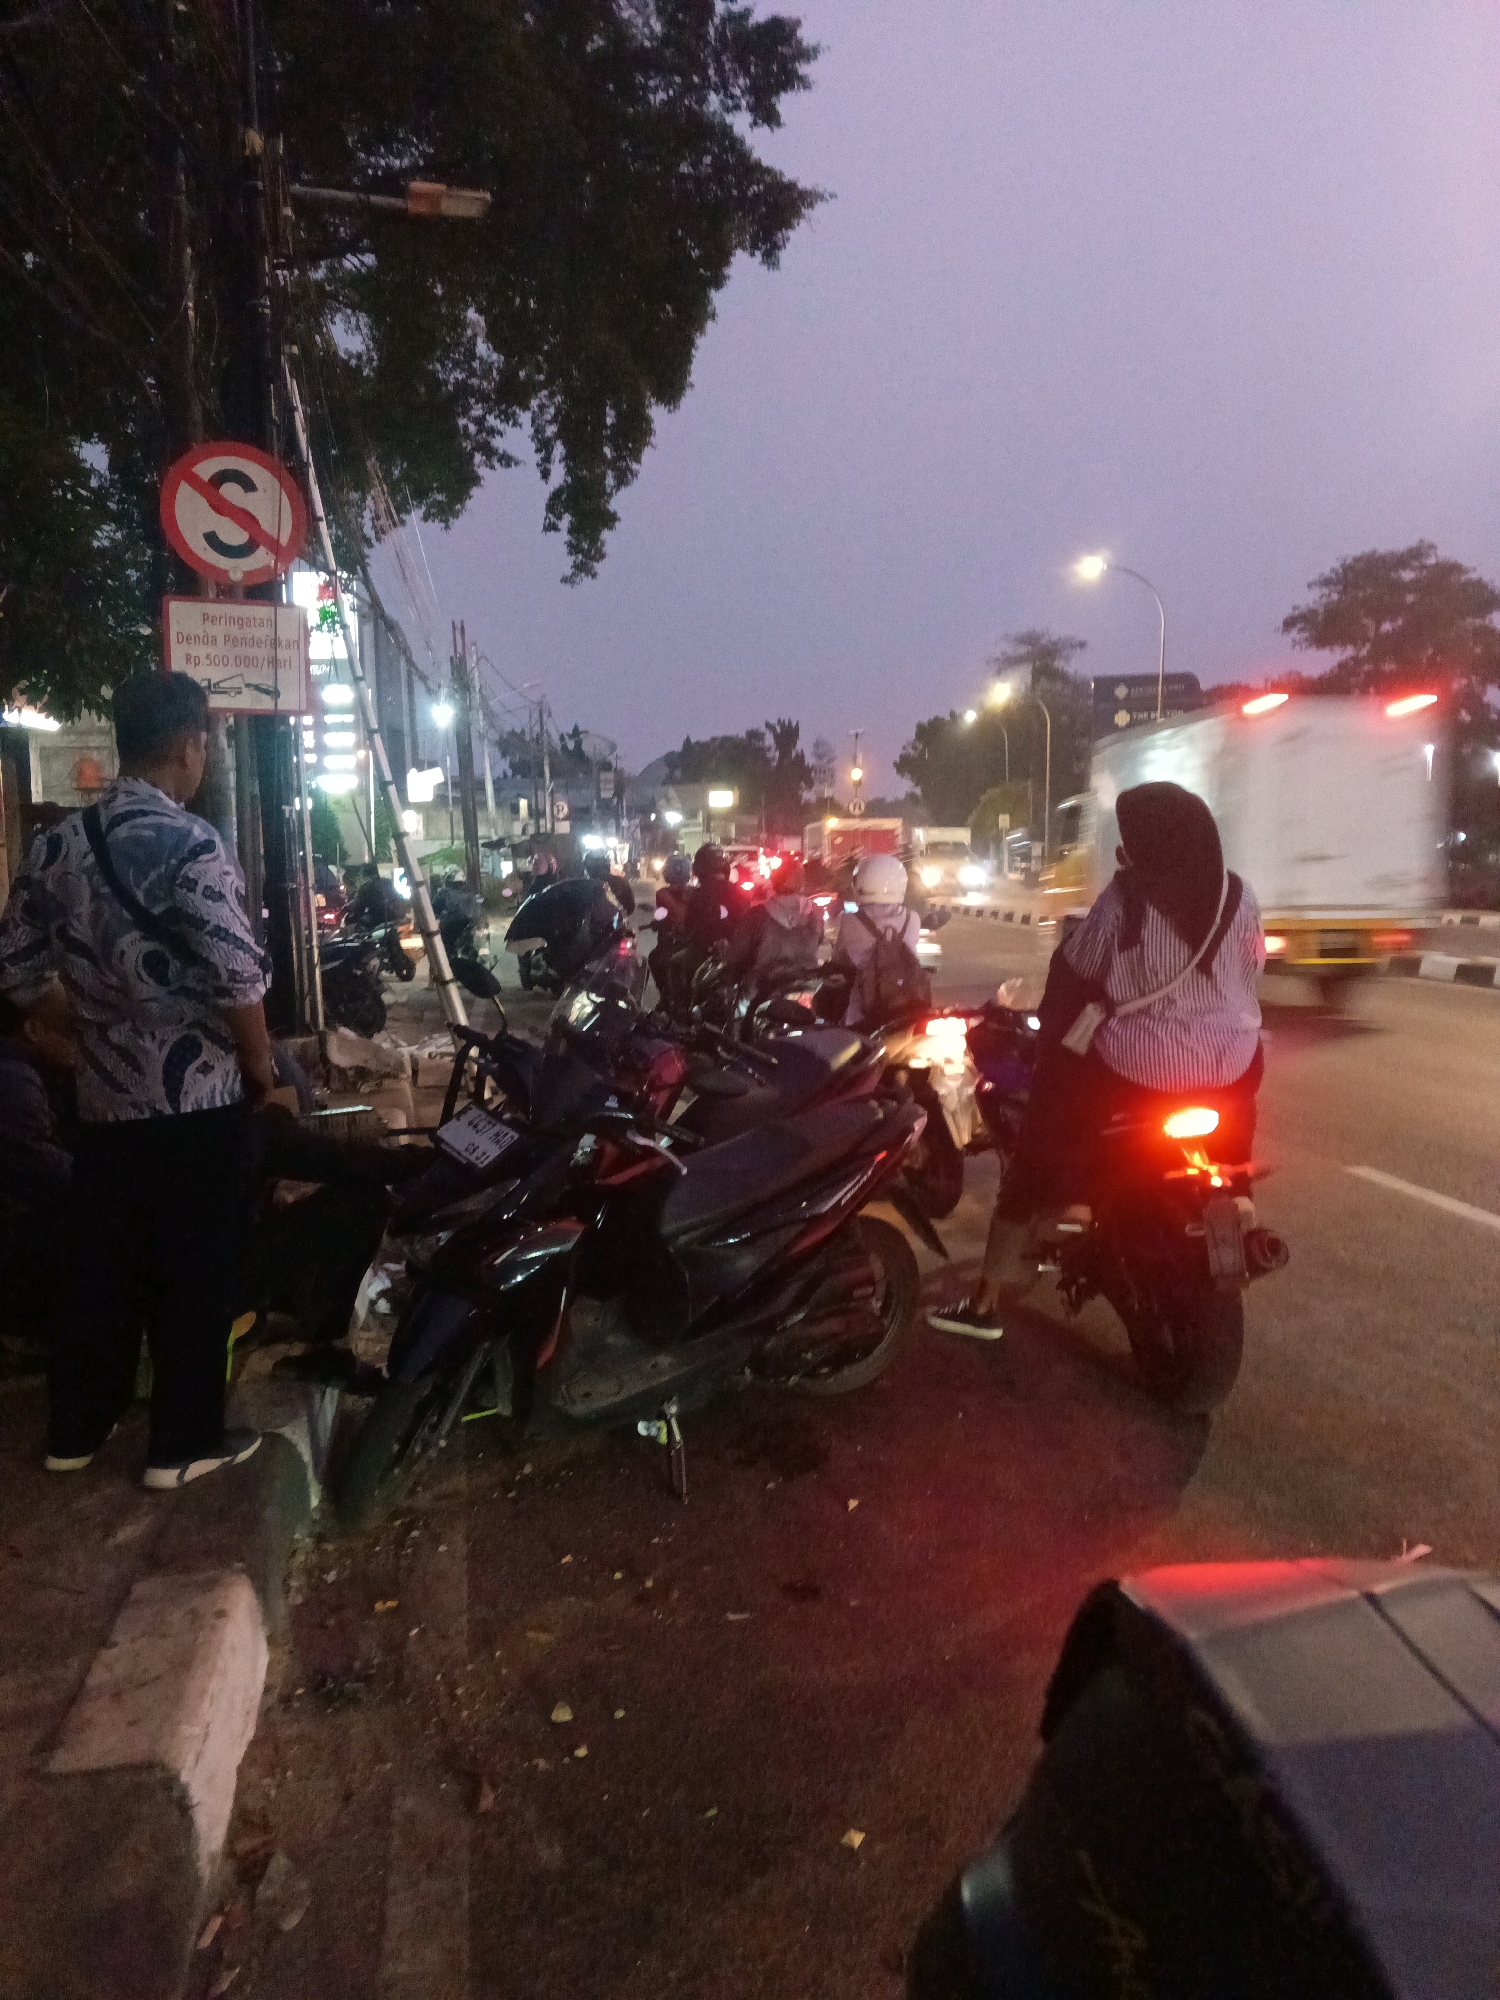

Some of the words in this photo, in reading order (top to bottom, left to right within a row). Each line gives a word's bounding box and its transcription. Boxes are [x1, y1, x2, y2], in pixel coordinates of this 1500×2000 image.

[202, 612, 273, 629] Peringatan
[176, 631, 218, 647] Denda
[223, 634, 300, 651] Penderekan
